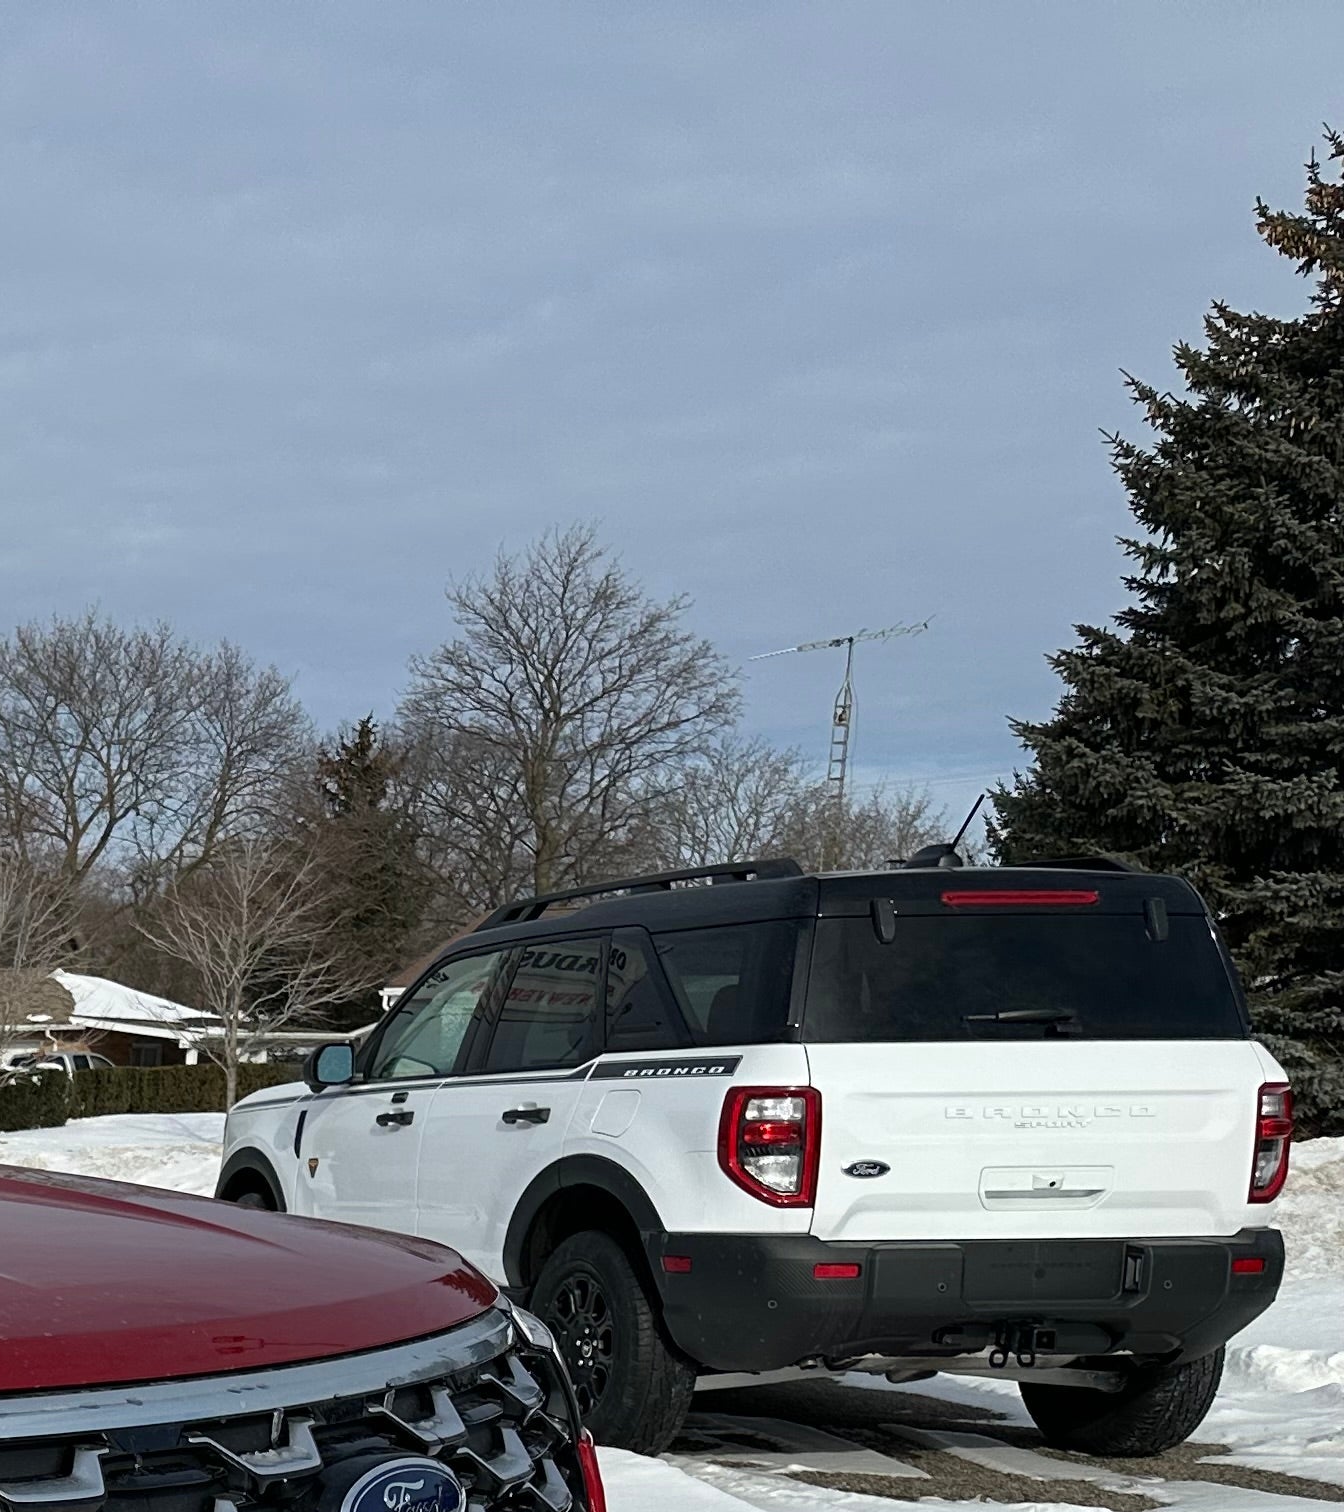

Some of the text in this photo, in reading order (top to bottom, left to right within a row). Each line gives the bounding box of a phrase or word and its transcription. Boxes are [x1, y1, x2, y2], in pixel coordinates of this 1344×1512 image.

[623, 1065, 725, 1078] BRONCO
[944, 1105, 1157, 1119] BRONCO
[1014, 1117, 1093, 1129] SPORT
[852, 1163, 881, 1175] Ford
